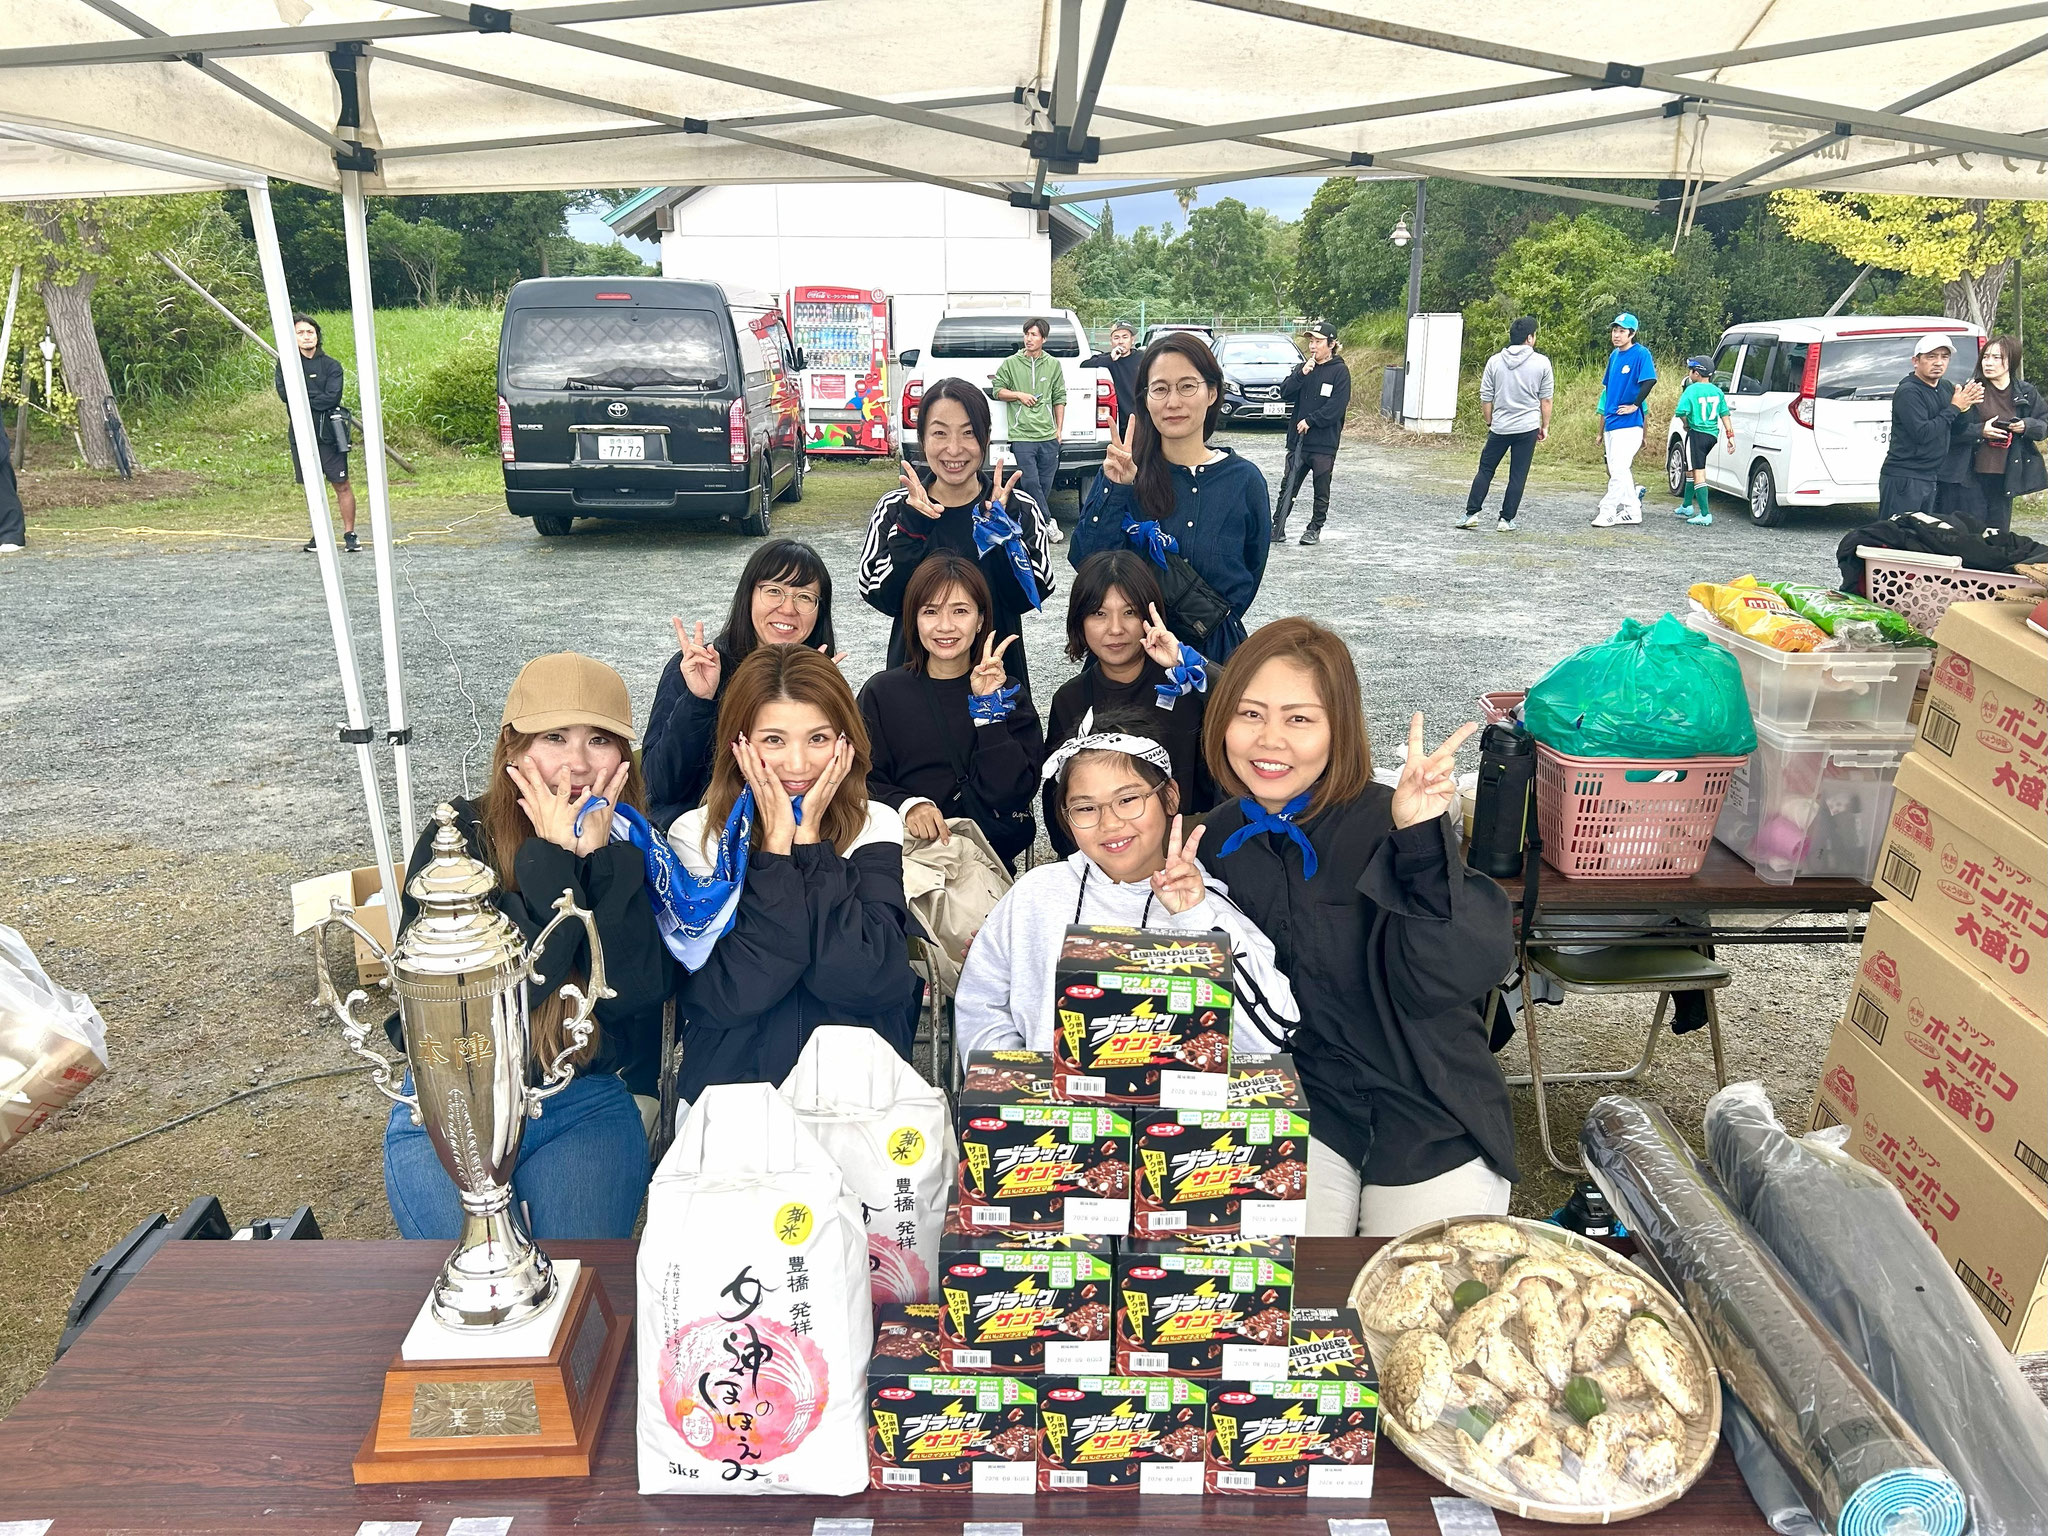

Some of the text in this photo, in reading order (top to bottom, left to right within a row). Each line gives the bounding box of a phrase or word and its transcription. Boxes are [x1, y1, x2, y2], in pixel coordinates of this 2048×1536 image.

[1698, 395, 1720, 422] 17
[609, 445, 642, 458] 77-72
[1992, 761, 2048, 816] 大盛
[1992, 855, 2031, 885] カップ
[1957, 860, 2048, 939] ポンポコ
[1981, 903, 2022, 939] ラーメン
[1954, 912, 2030, 975] 大盛り
[1089, 1012, 1176, 1049] ブラック
[1111, 1033, 1177, 1054] サンダー
[1957, 1016, 1995, 1048] カップ
[1923, 1016, 2019, 1102] ポンポコ
[1945, 1060, 1987, 1099] ラーメン
[1922, 1067, 1995, 1133] 大盛り
[891, 1130, 920, 1161] 新米
[993, 1144, 1078, 1177] ブラック
[1906, 1136, 1941, 1169] カップ
[1014, 1163, 1079, 1182] サンダー
[1170, 1146, 1256, 1183] ブラック
[1191, 1166, 1257, 1187] サンダー
[1876, 1132, 1960, 1222] ポンポコ
[1896, 1175, 1931, 1216] ラーメン
[778, 1205, 808, 1241] 新米
[894, 1178, 917, 1251] 豊橋 発祥
[787, 1256, 813, 1337] 豊橋 発祥
[973, 1289, 1059, 1323] ブラック
[1152, 1292, 1238, 1325] ブラック
[995, 1308, 1060, 1327] サンダー
[1173, 1311, 1239, 1330] サンダー
[902, 1412, 986, 1443] ブラック
[924, 1430, 987, 1447] サンダー
[1071, 1413, 1155, 1444] ブラック
[1092, 1431, 1156, 1449] サンダー
[1241, 1416, 1325, 1447] ブラック
[1261, 1434, 1325, 1451] サンダー
[668, 1461, 700, 1479] 5kg
